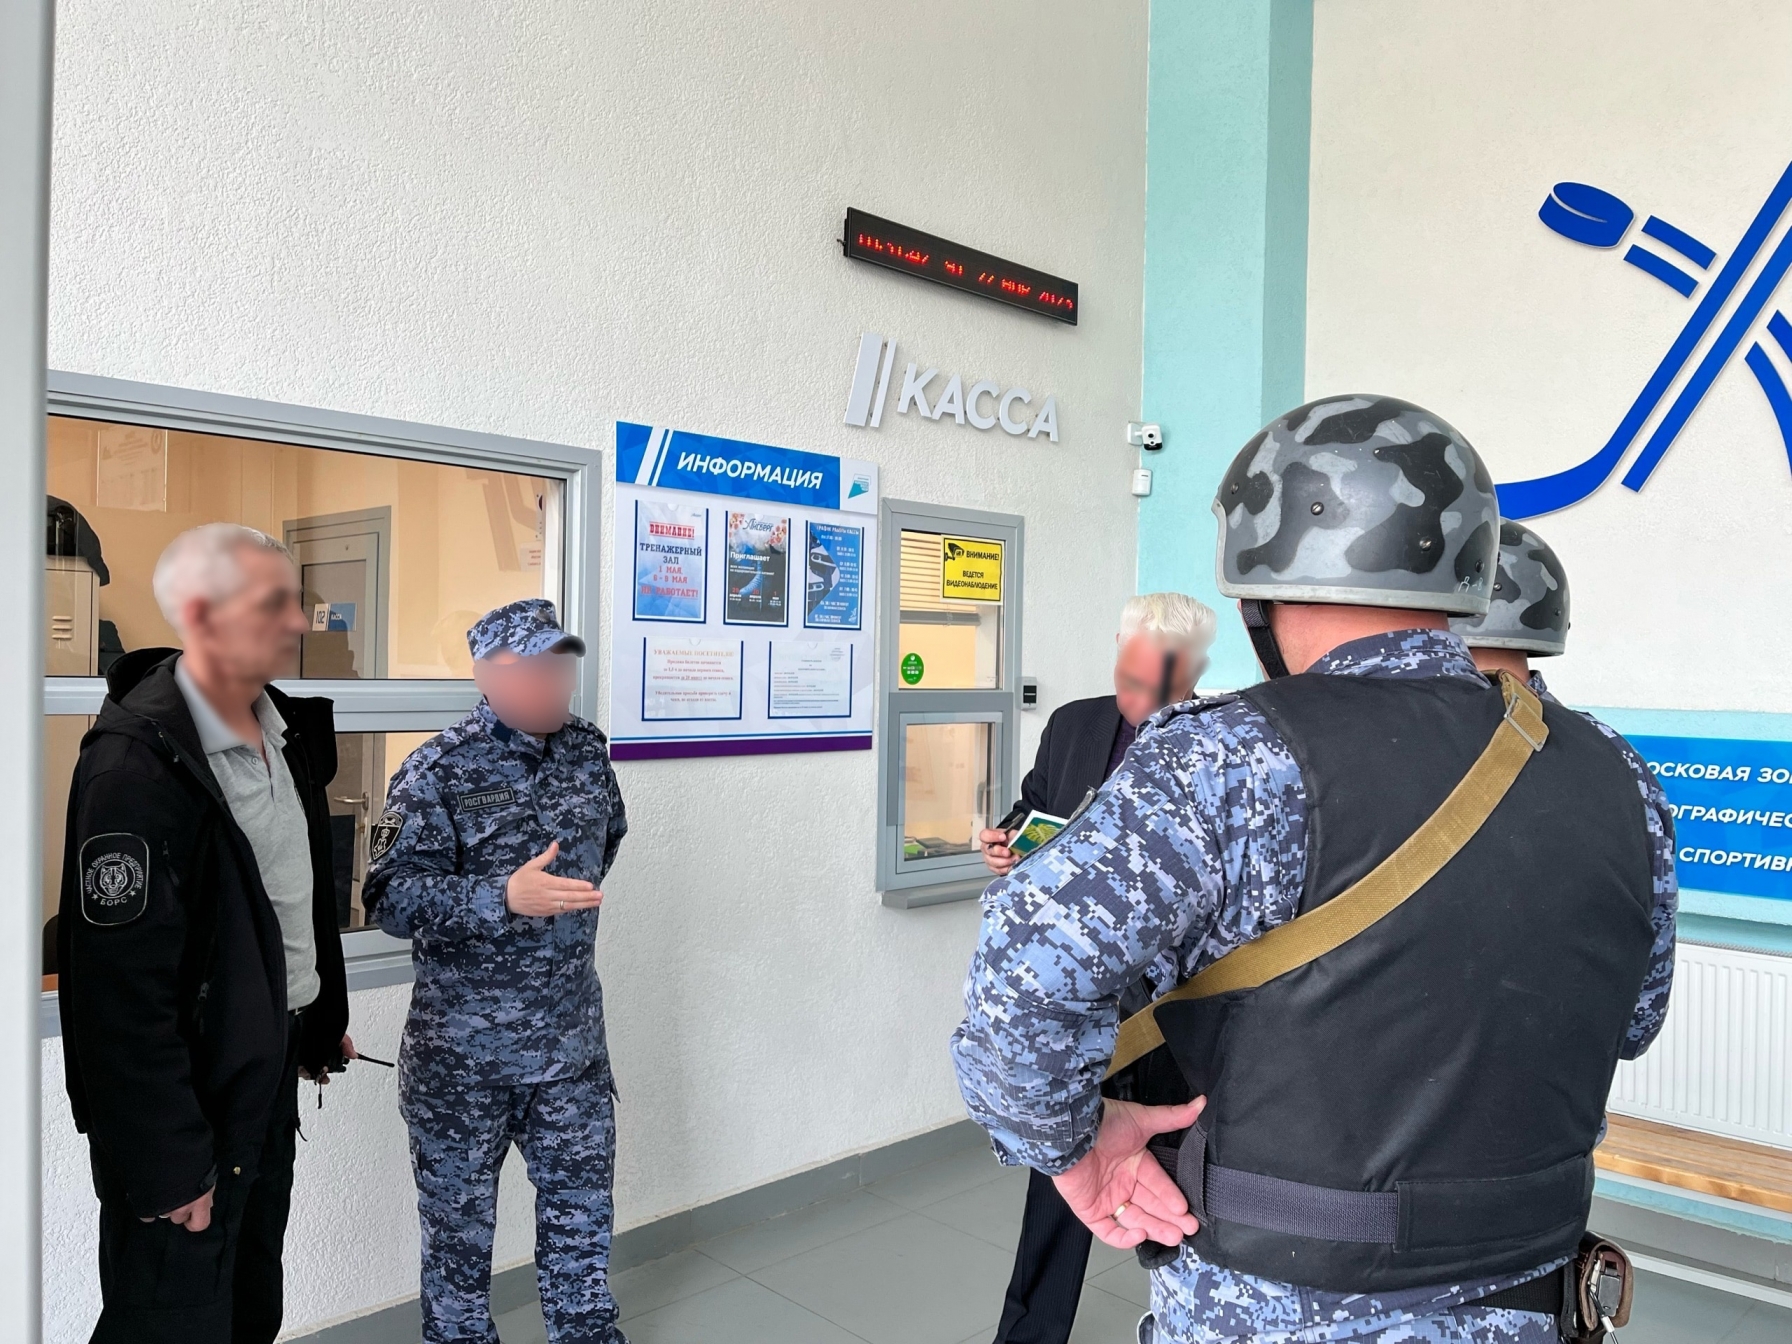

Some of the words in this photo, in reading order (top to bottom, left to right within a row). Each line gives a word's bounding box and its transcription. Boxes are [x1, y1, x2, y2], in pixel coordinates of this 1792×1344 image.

[897, 363, 1059, 442] КАССА
[677, 452, 823, 489] ИНФОРМАЦИЯ
[649, 523, 695, 538] ВНИМАНИЕ!
[639, 542, 702, 556] ТРЕНАЖЕРНЫЙ
[966, 551, 999, 560] ВНИМАНИЕ!
[663, 556, 679, 565] ЗАЛ
[730, 552, 770, 562] Приглашает
[672, 576, 687, 584] МАЯ
[962, 570, 984, 579] ВЕДЕТСЯ
[946, 580, 998, 590] ВИДЕОНАБЛЮДЕНИЕ
[656, 586, 698, 598] РАБОТАЕТ!
[316, 610, 325, 624] 102
[1757, 767, 1792, 784] ЗО
[464, 791, 509, 807] РОСГВАРДИЯ
[91, 852, 122, 868] ОХРАННОЕ
[122, 853, 144, 890] ПРЕДПРИЯТИЕ
[100, 896, 127, 906] БОРС
